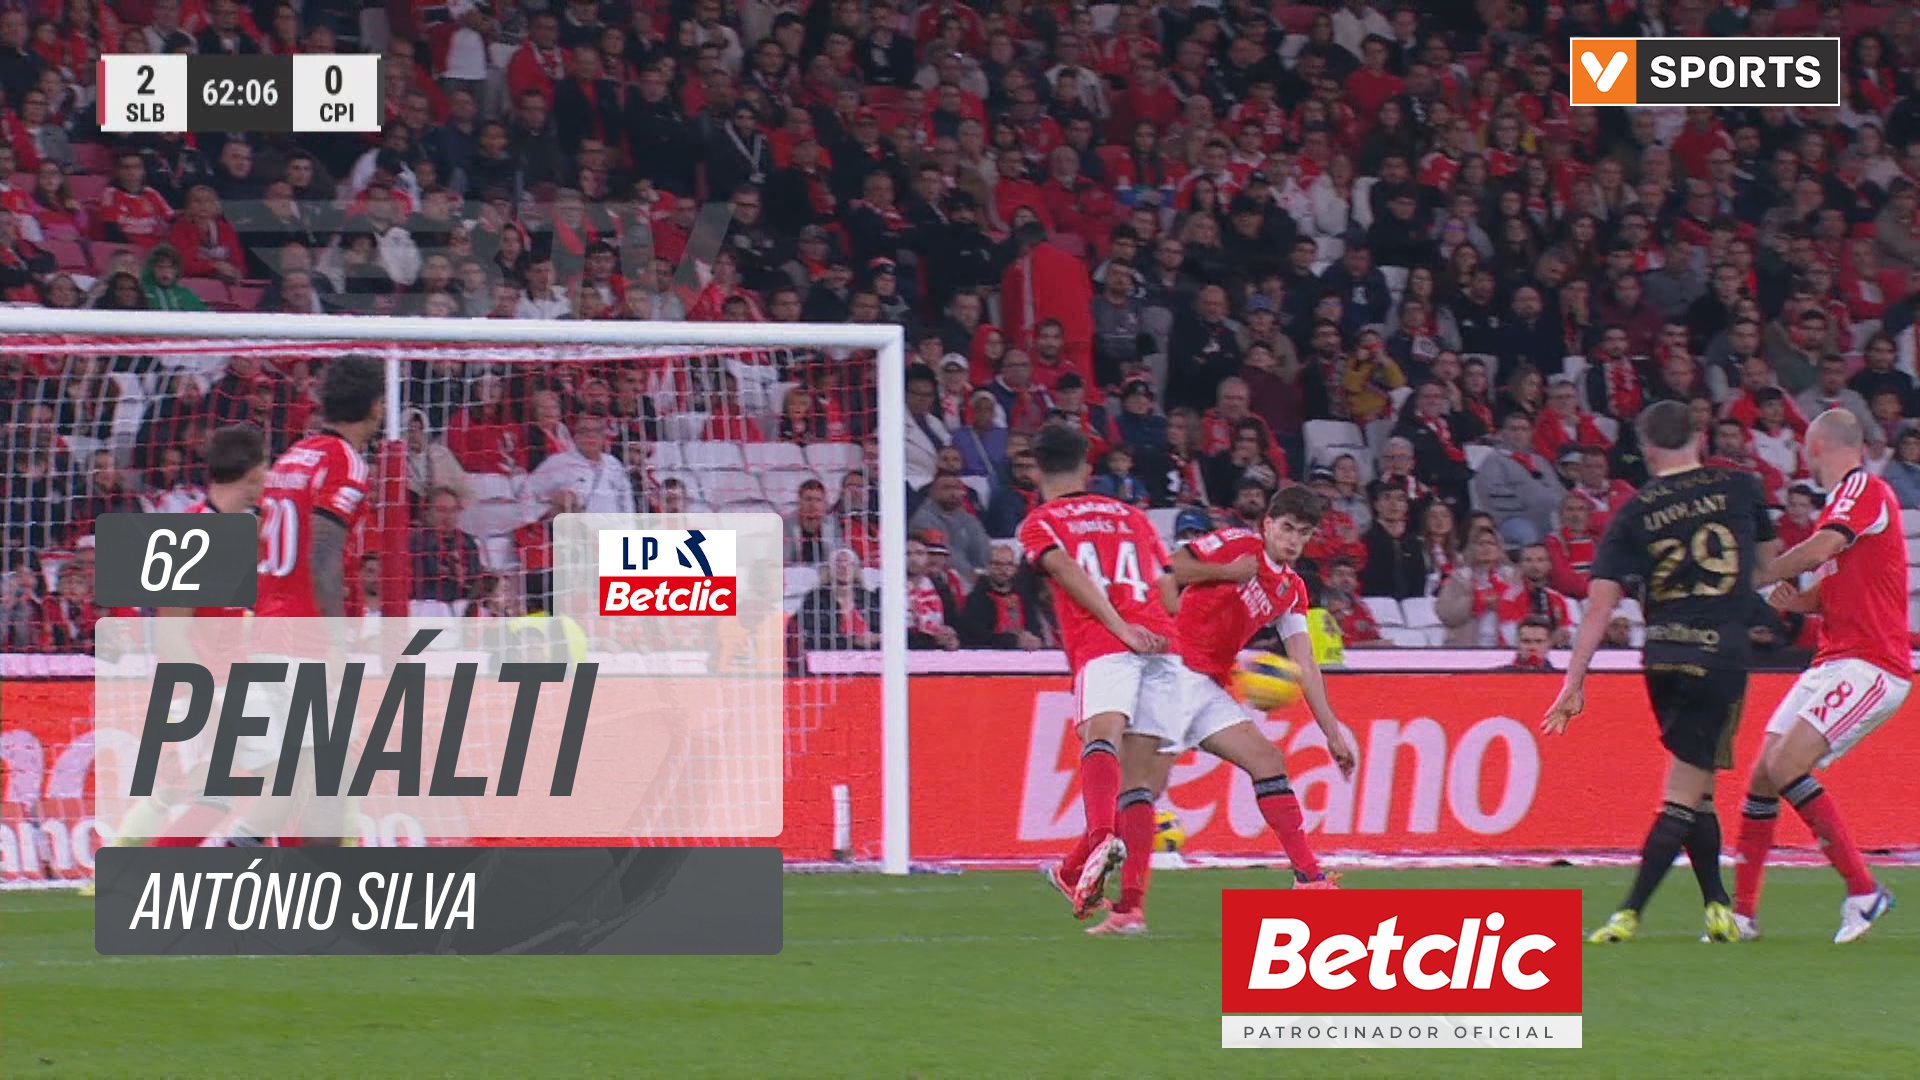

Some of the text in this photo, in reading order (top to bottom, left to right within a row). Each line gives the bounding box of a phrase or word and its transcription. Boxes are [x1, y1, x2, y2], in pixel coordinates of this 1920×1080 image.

[1075, 541, 1149, 602] 44
[1648, 522, 1739, 601] 29
[1824, 680, 1853, 708] 8
